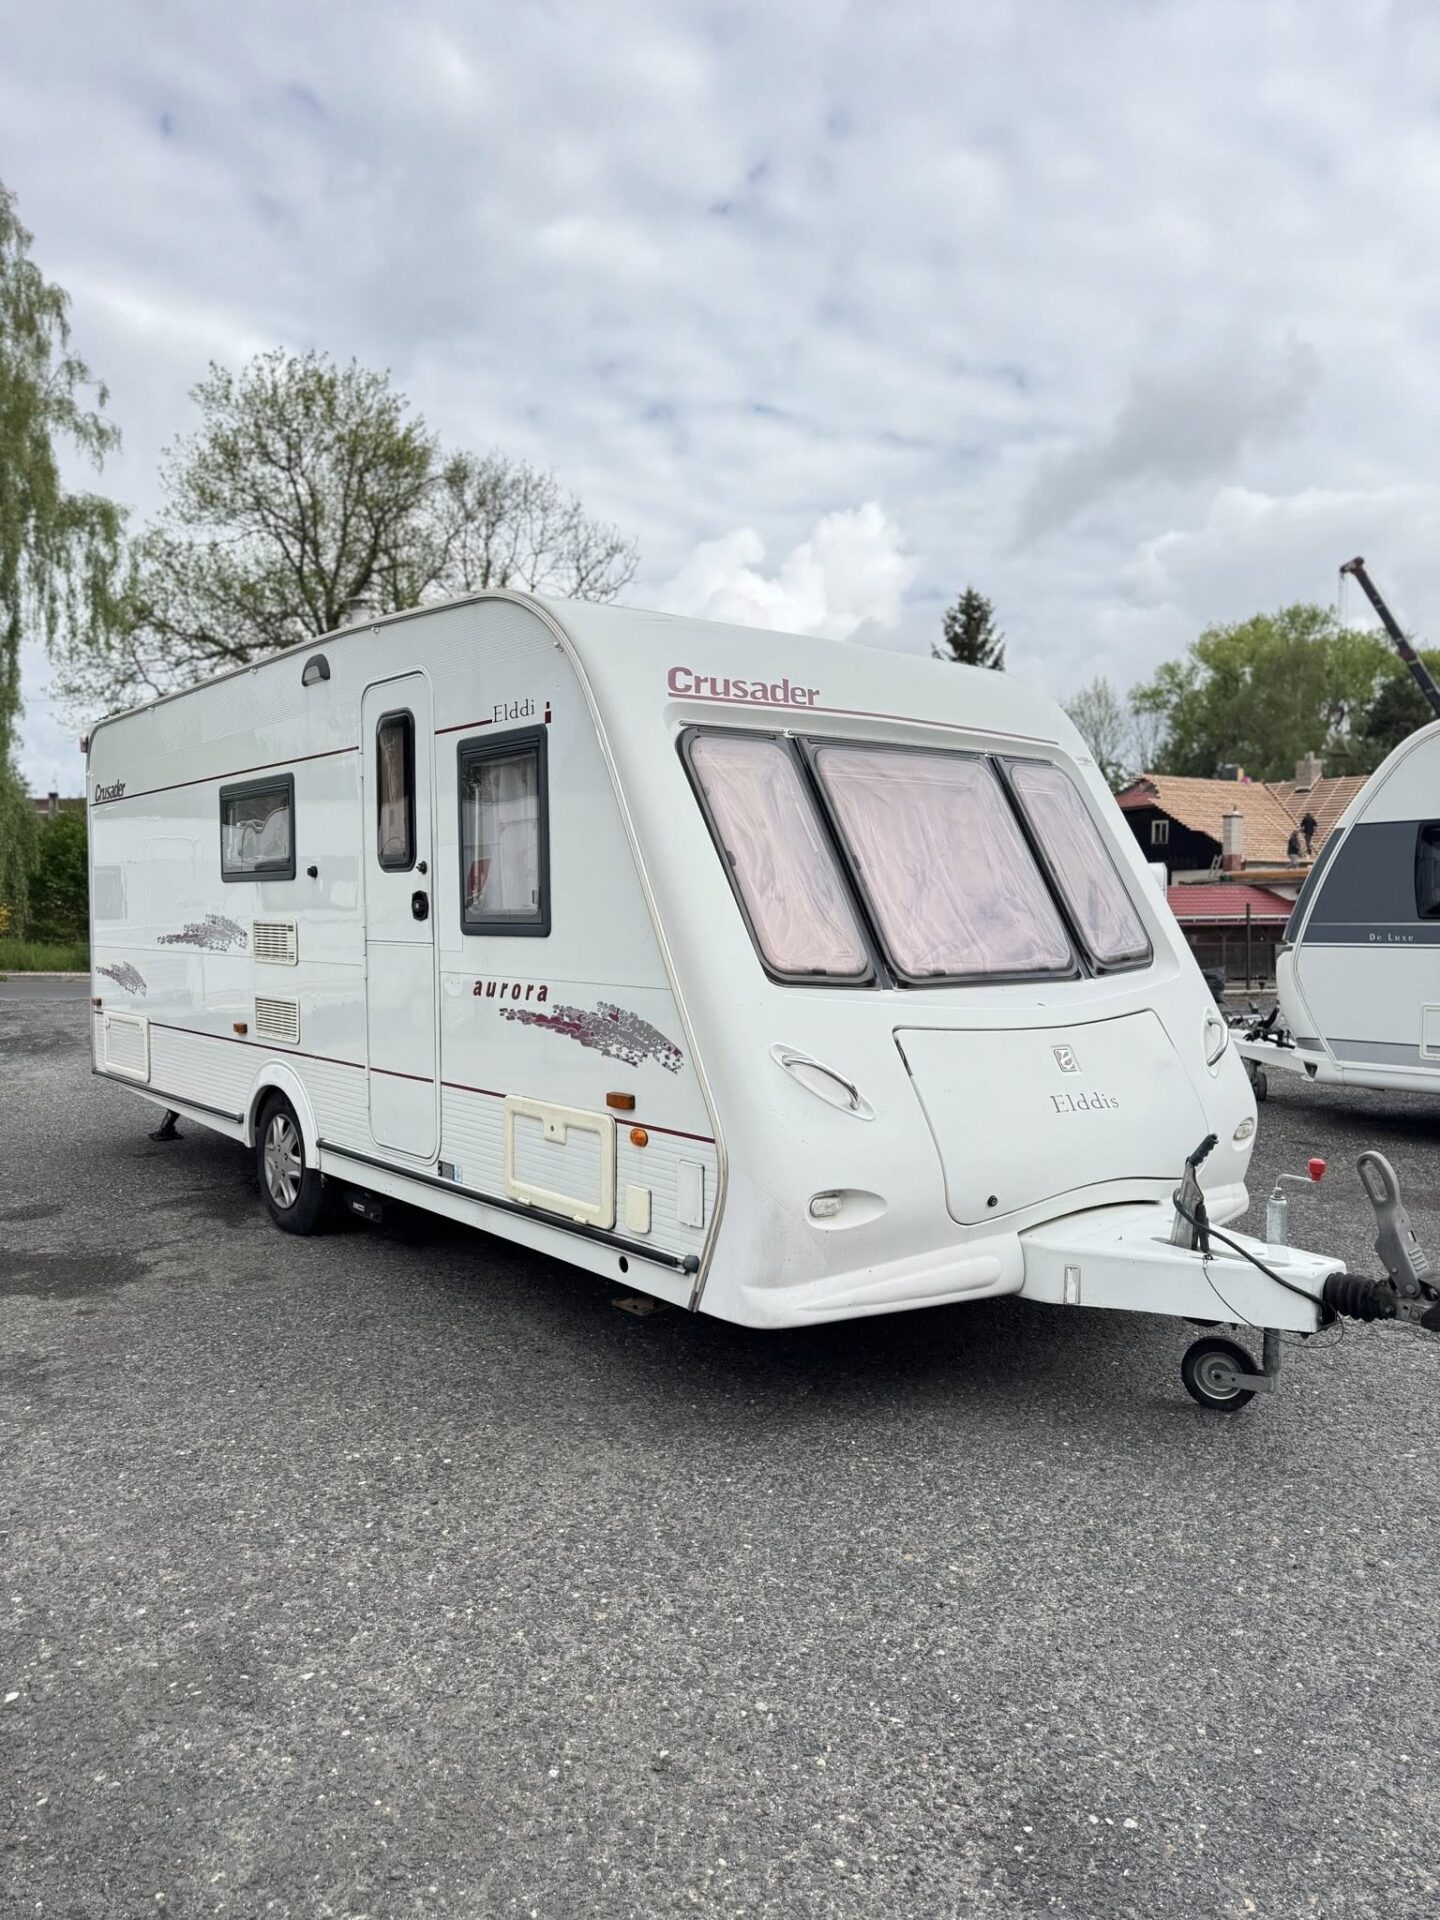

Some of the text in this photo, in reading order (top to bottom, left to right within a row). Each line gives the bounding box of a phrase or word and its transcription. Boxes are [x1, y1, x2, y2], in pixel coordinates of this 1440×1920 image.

[667, 666, 820, 706] Crusader
[95, 779, 126, 802] Crusader
[1369, 933, 1414, 941] De Luxe
[473, 980, 548, 1002] aurora
[1049, 1091, 1119, 1113] Elddis
